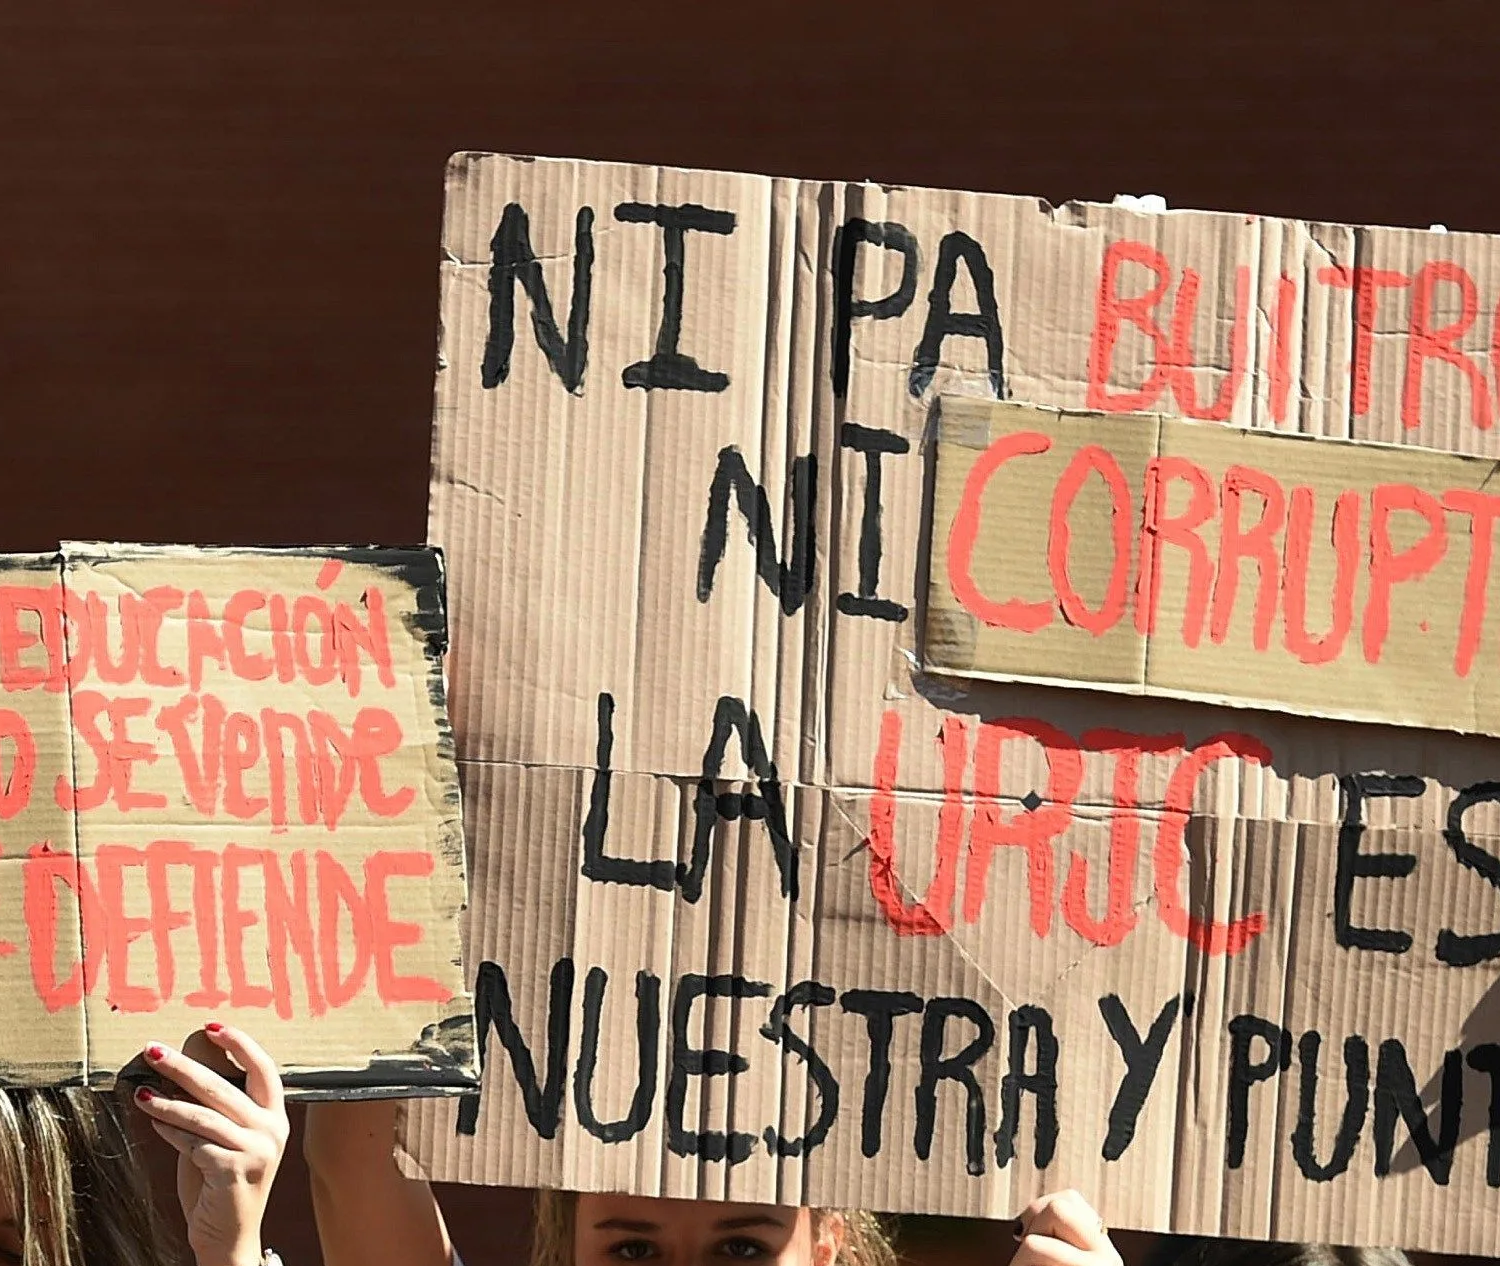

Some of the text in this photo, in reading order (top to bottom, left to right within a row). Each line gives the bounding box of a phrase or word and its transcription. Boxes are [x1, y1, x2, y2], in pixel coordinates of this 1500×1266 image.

[481, 202, 737, 394] NI
[832, 217, 1004, 399] PA
[697, 422, 910, 616] NI
[55, 692, 158, 812] SE
[581, 692, 799, 903] LA
[869, 710, 1272, 955] URJC
[23, 840, 453, 1016] DEFIENDE
[456, 957, 1059, 1176] NUESTRA
[1098, 992, 1195, 1162] Y
